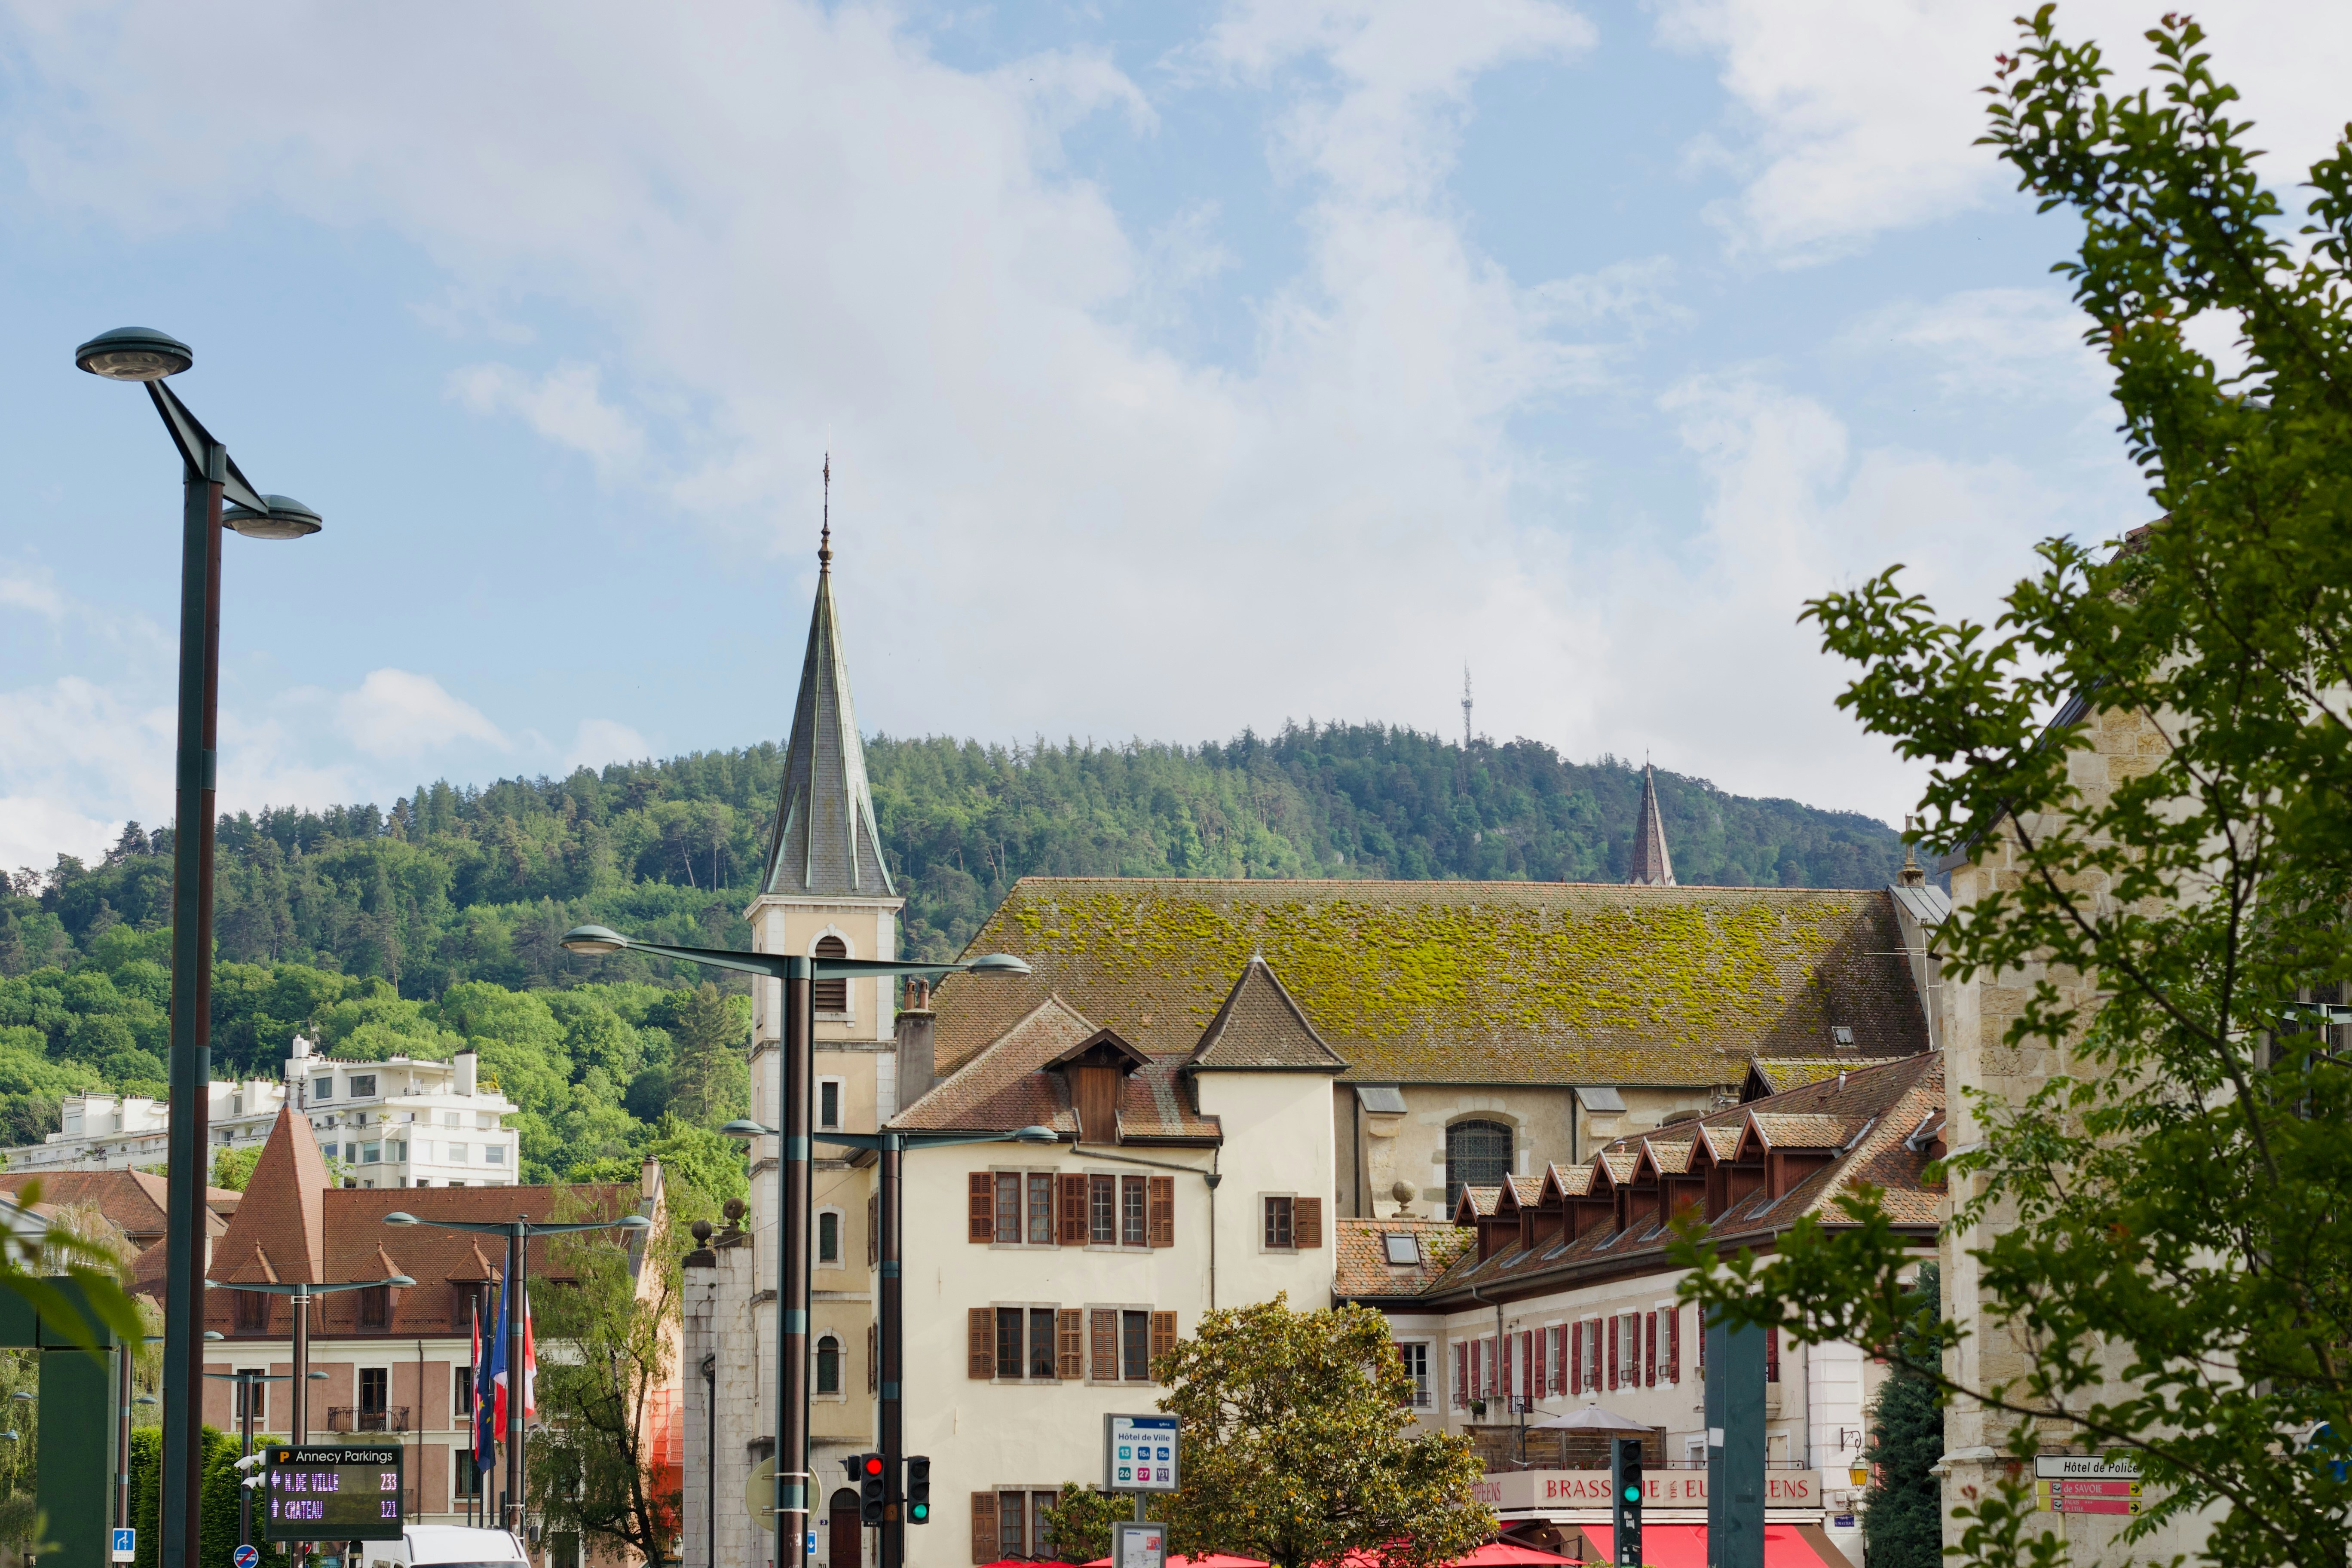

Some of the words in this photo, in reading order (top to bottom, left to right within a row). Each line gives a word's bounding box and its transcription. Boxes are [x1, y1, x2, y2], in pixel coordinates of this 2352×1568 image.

[280, 1452, 289, 1462] P
[296, 1451, 342, 1464] Annecy
[345, 1451, 392, 1464] Parkings
[2064, 1462, 2090, 1472] Hôtel
[2094, 1462, 2105, 1473] de
[2108, 1463, 2138, 1473] Police
[311, 1473, 339, 1492] VILLE
[380, 1473, 397, 1491] 233
[1546, 1480, 1660, 1498] BRASSIE
[2064, 1485, 2072, 1493] de
[2075, 1484, 2102, 1493] SAVOIE
[285, 1501, 323, 1519] CHATEAU
[380, 1501, 397, 1518] 121
